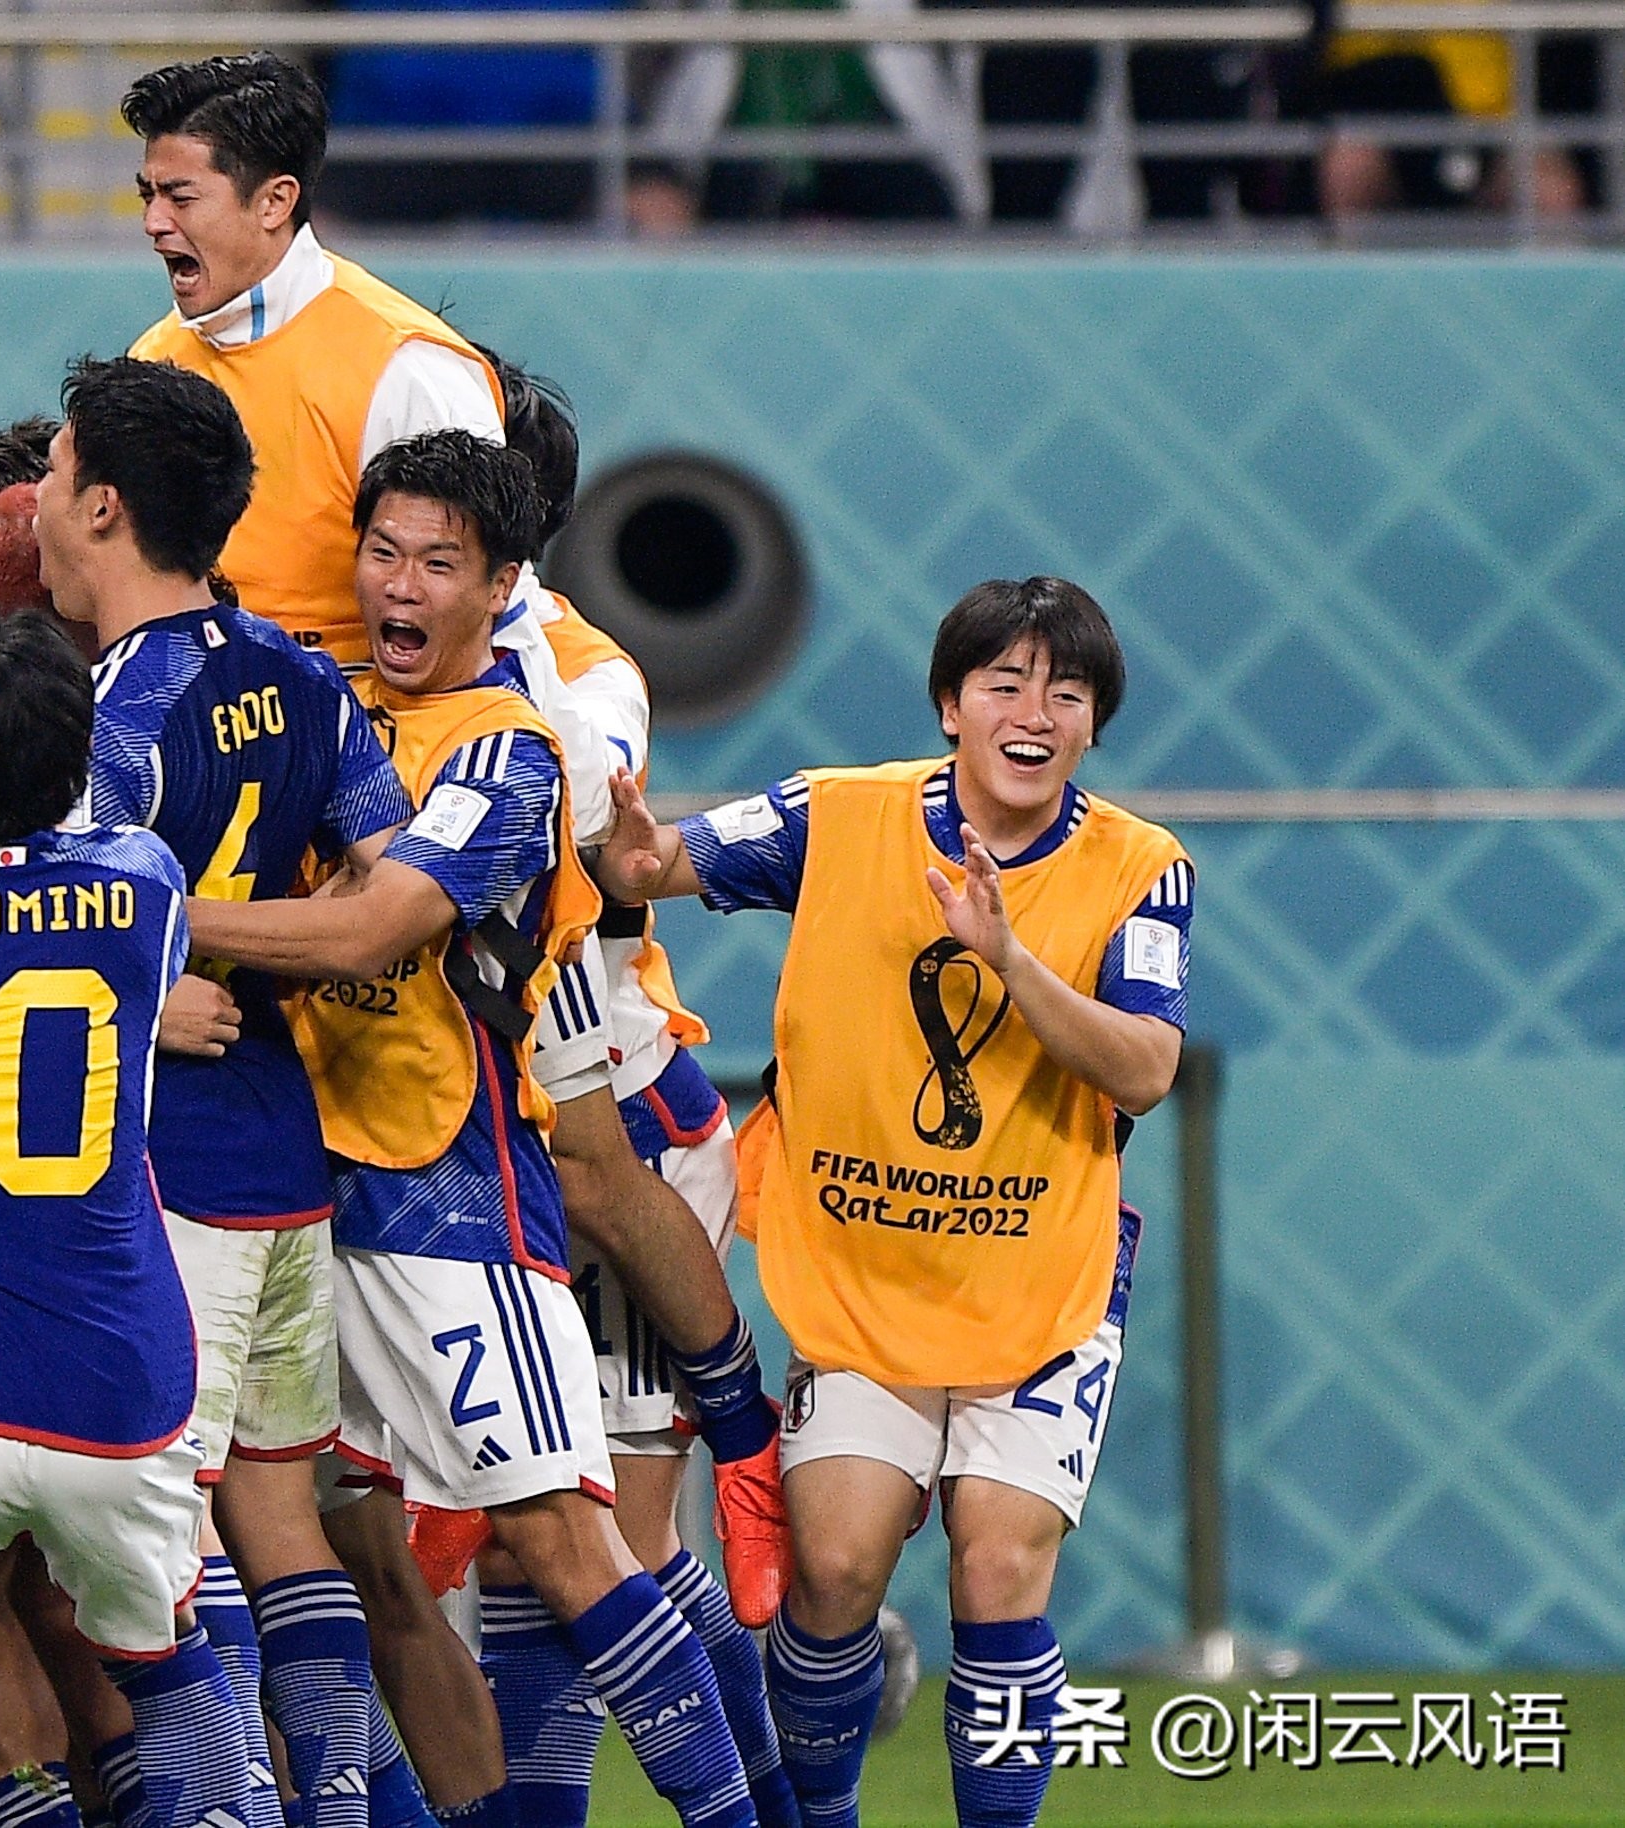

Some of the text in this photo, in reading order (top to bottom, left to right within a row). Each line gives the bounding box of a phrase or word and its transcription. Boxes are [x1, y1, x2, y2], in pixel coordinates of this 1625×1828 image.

[212, 686, 285, 753] ENDO
[378, 958, 421, 983] UP
[810, 1149, 1050, 1202] FIFA WORLD CUP
[431, 1323, 502, 1428] 2
[1011, 1349, 1111, 1445] 24
